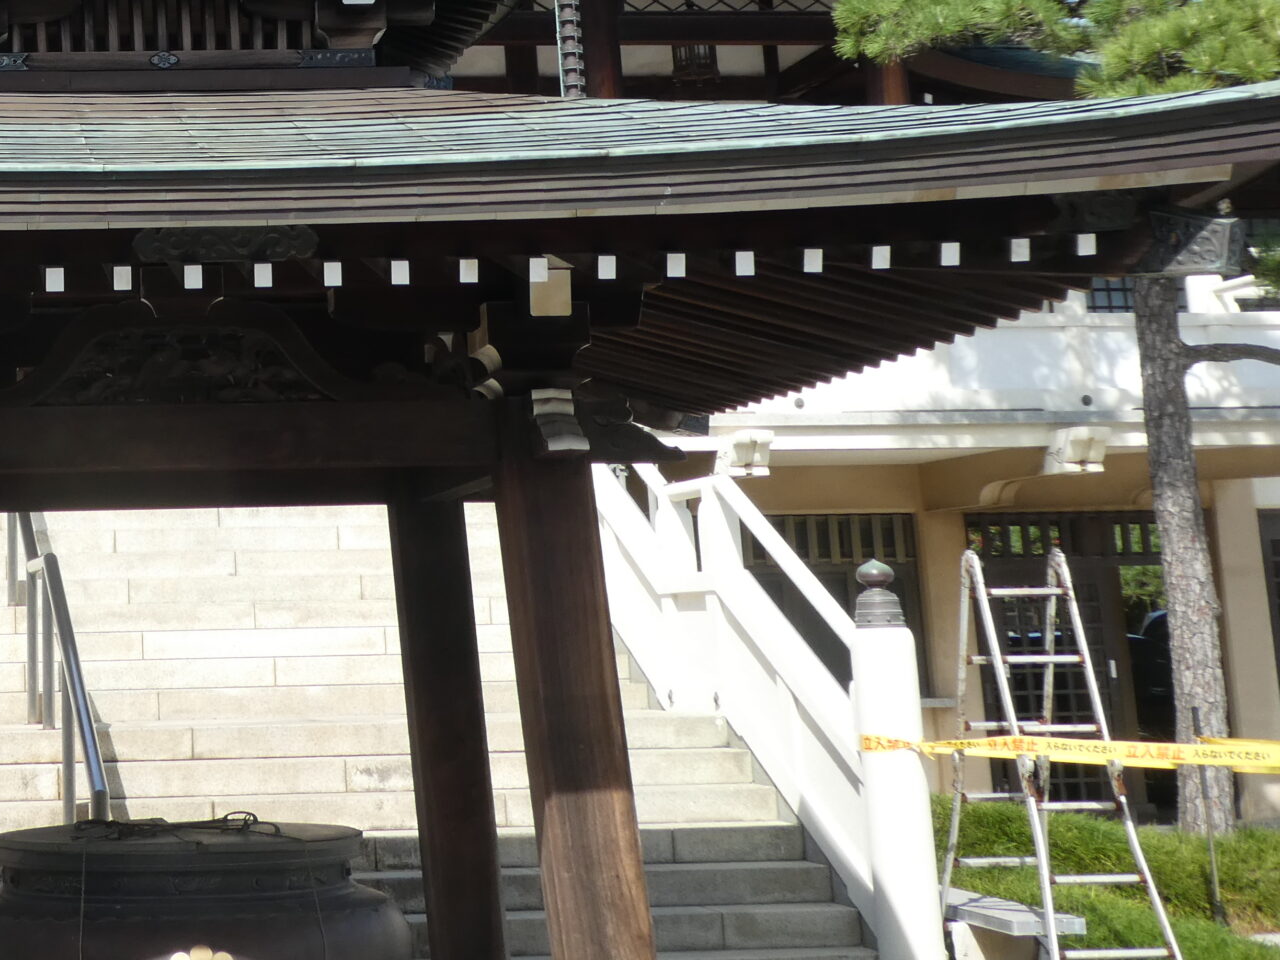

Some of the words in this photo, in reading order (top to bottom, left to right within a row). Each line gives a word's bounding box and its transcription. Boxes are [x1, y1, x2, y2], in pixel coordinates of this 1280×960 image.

[987, 738, 1039, 752] 立入禁止
[1046, 742, 1117, 754] 入らないでください
[1125, 744, 1186, 760] 立入禁止
[1193, 748, 1271, 761] 入らないでください
